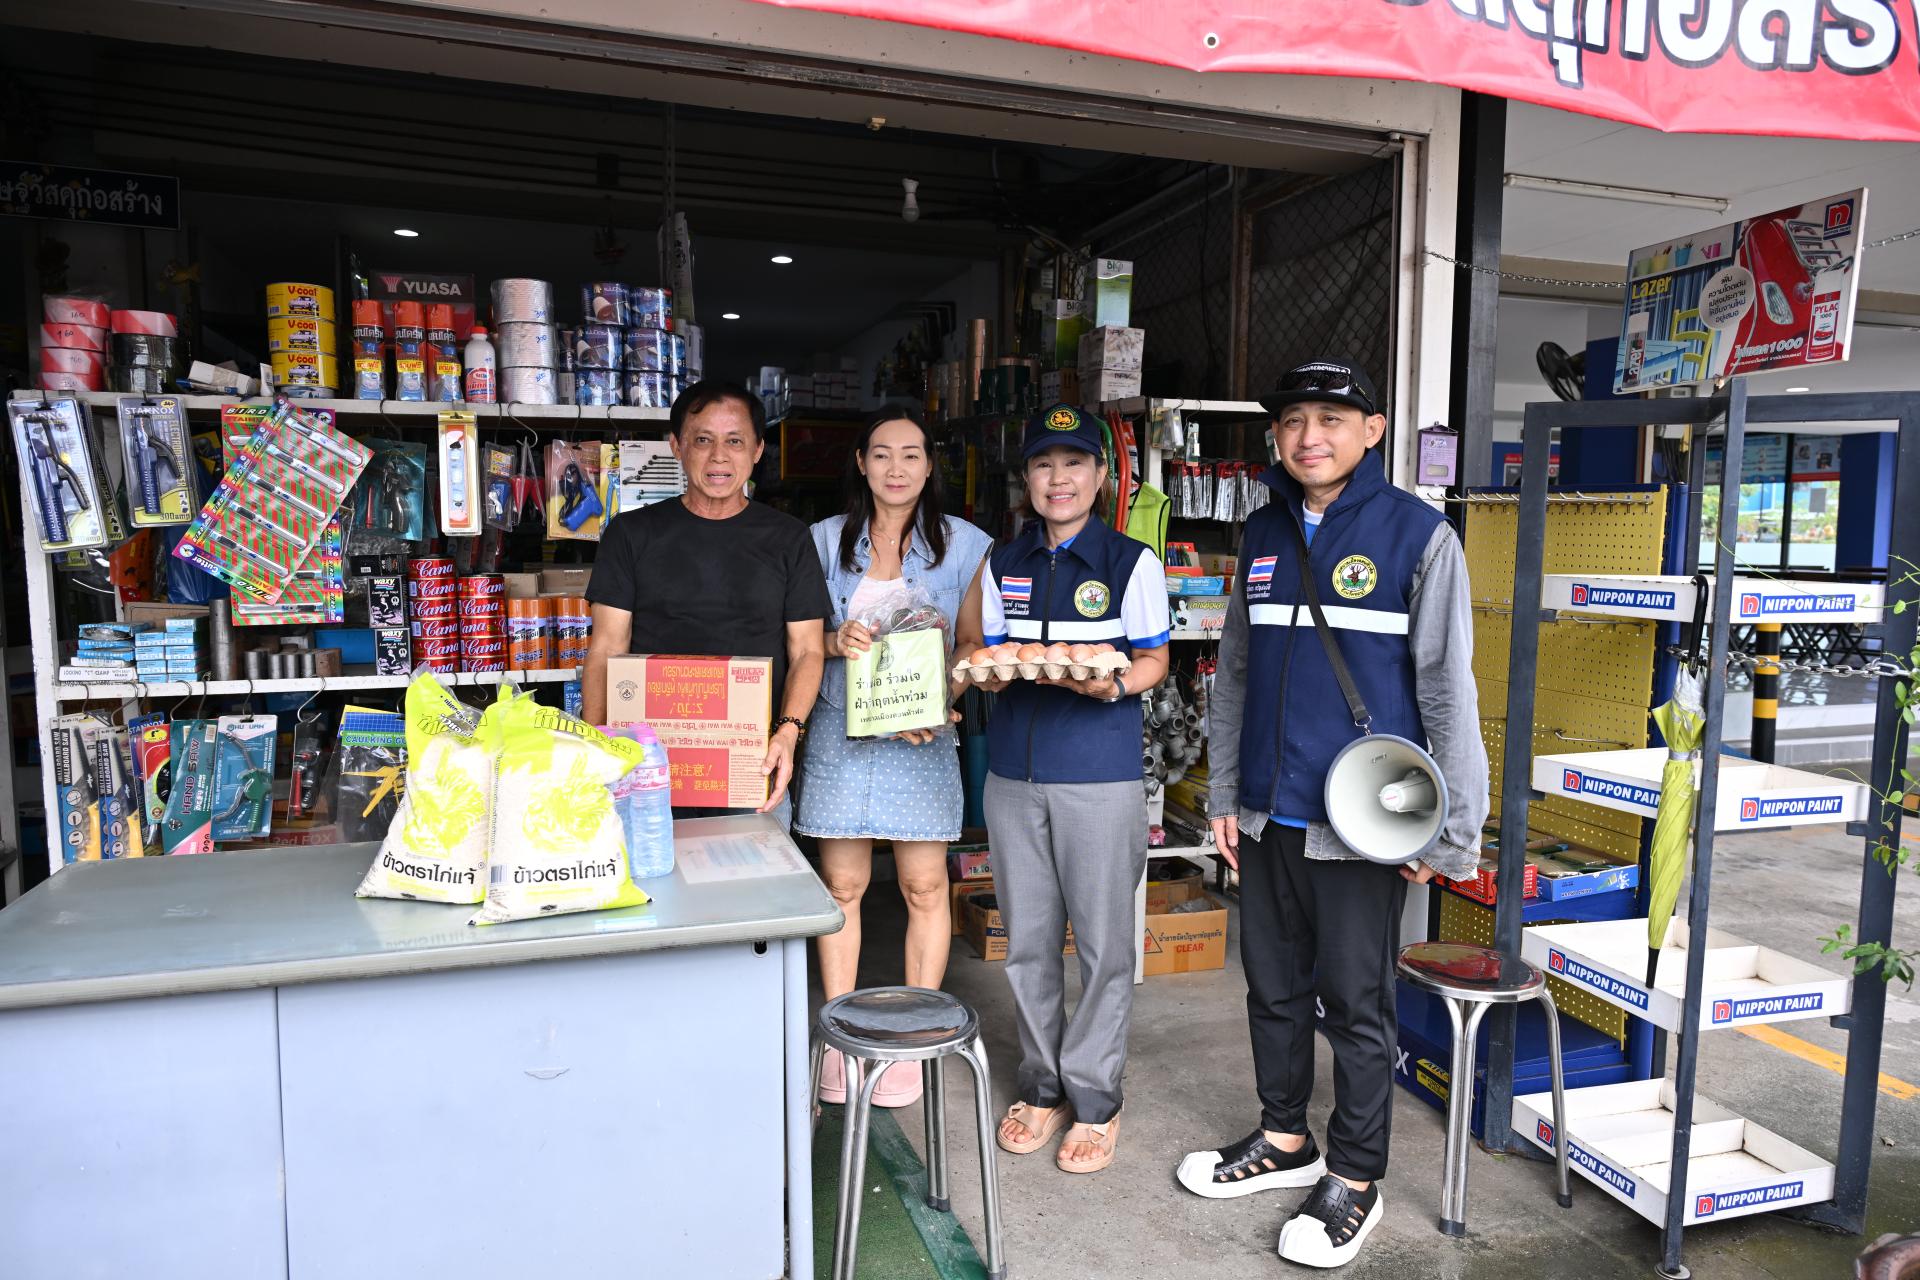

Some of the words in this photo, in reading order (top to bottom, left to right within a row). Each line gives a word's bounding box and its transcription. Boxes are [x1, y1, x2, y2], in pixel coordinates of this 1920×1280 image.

[403, 281, 462, 296] YUASA
[1631, 275, 1672, 300] Lazer
[1814, 302, 1839, 314] PYLAC
[225, 407, 268, 415] BIRD
[192, 556, 219, 573] Cutter
[416, 560, 454, 577] Cana
[374, 578, 395, 586] waxy
[418, 580, 455, 597] Cana
[464, 600, 499, 615] Cana
[1591, 591, 1634, 606] NIPPON
[1636, 593, 1672, 608] PAINT
[1764, 597, 1813, 613] NIPPON
[1815, 595, 1854, 611] PAINT
[415, 600, 452, 617] Cana
[381, 630, 403, 638] waxy
[422, 621, 458, 638] Cana
[461, 619, 486, 634] ana
[423, 640, 460, 656] Cana
[467, 639, 502, 655] Cana
[345, 735, 393, 744] CAULKING
[63, 748, 71, 785] WALLBOARD
[181, 776, 195, 815] HAND
[188, 738, 200, 773] SAW
[1584, 778, 1630, 799] NIPPON
[1760, 800, 1805, 815] NIPPON
[1807, 797, 1842, 812] PAINT
[302, 832, 331, 845] FOX
[382, 851, 476, 884] ข้าวตราไก่แจ้
[513, 858, 617, 883] ข้าวตราไก่แจ้
[1176, 943, 1205, 953] CLEAR
[1566, 961, 1608, 990] NIPPON
[1609, 978, 1647, 1006] PAINT
[1735, 1000, 1780, 1016] NIPPON
[1782, 995, 1821, 1012] PAINT
[1567, 1143, 1598, 1175] PPON
[1598, 1159, 1635, 1196] PAINT
[1717, 1192, 1761, 1209] NIPPON
[1763, 1184, 1802, 1202] PAINT
